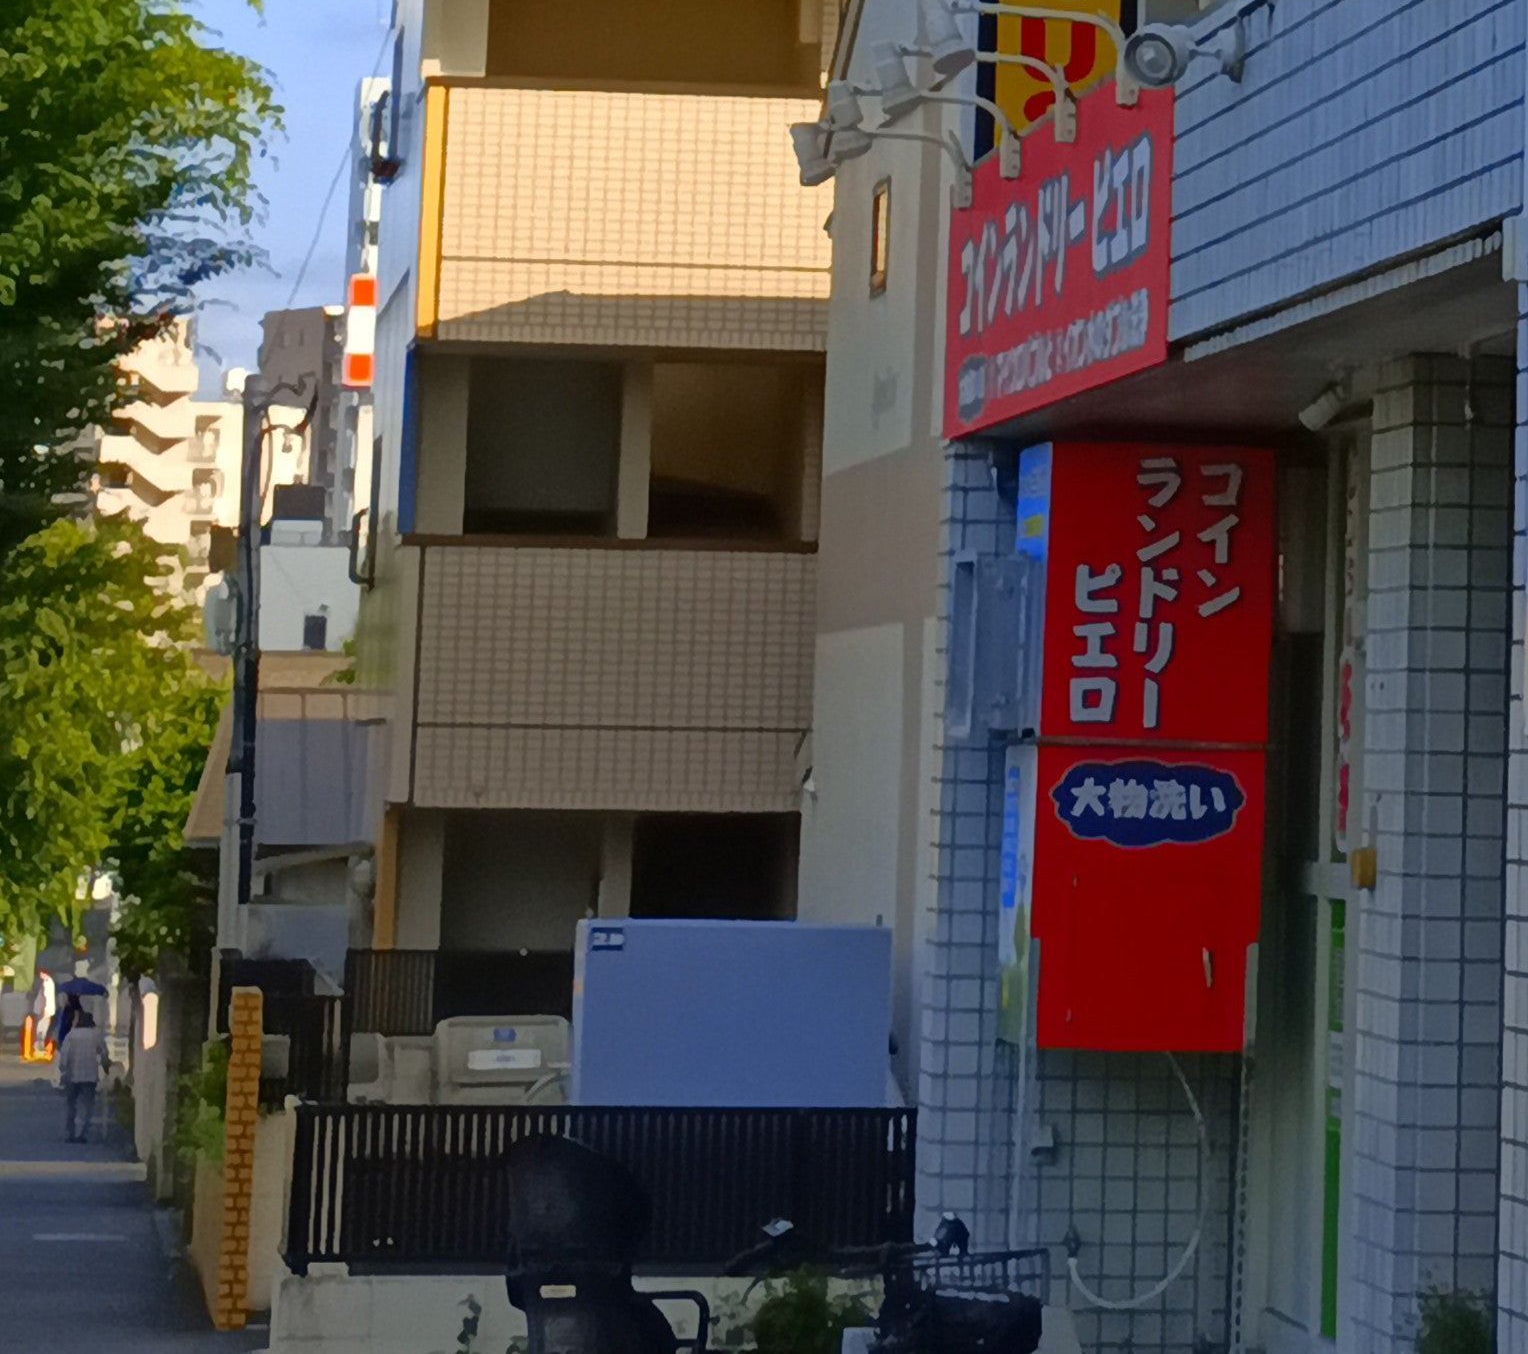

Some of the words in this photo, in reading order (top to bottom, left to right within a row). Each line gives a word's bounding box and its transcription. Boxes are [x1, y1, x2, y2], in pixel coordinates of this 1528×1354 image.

[1133, 457, 1182, 728] ランドリー
[1196, 463, 1243, 618] コイン
[1069, 563, 1122, 723] ピエロ
[1070, 777, 1227, 820] 大物洗い
